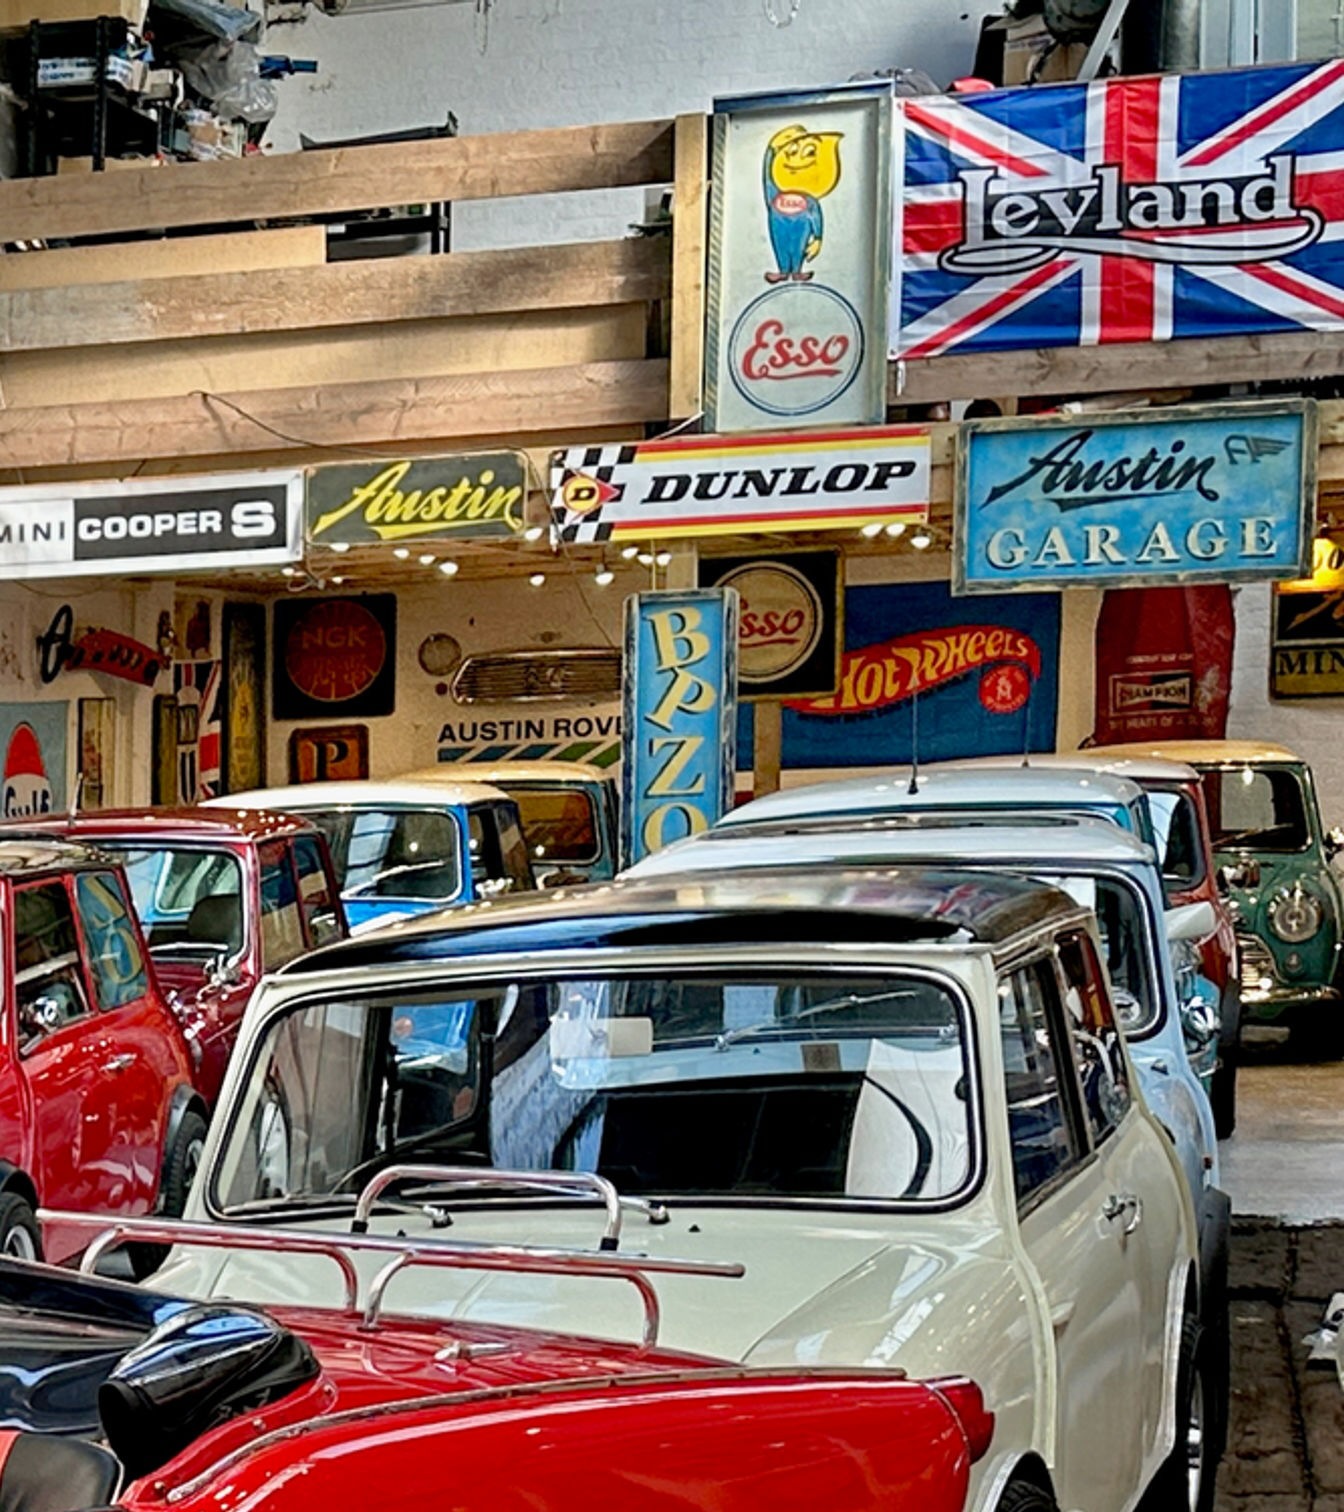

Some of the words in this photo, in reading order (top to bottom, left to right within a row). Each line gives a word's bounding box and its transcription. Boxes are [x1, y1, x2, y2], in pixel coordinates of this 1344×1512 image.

[742, 319, 850, 381] Esso
[641, 461, 917, 504] DUNLOP
[981, 430, 1221, 513] Austin
[78, 510, 223, 541] COOPER
[231, 500, 276, 540] S
[313, 461, 524, 541] Austin
[985, 515, 1278, 571] GARAGE
[302, 626, 368, 649] NGK
[438, 718, 545, 744] AUSTIN
[643, 606, 718, 858] BPZO
